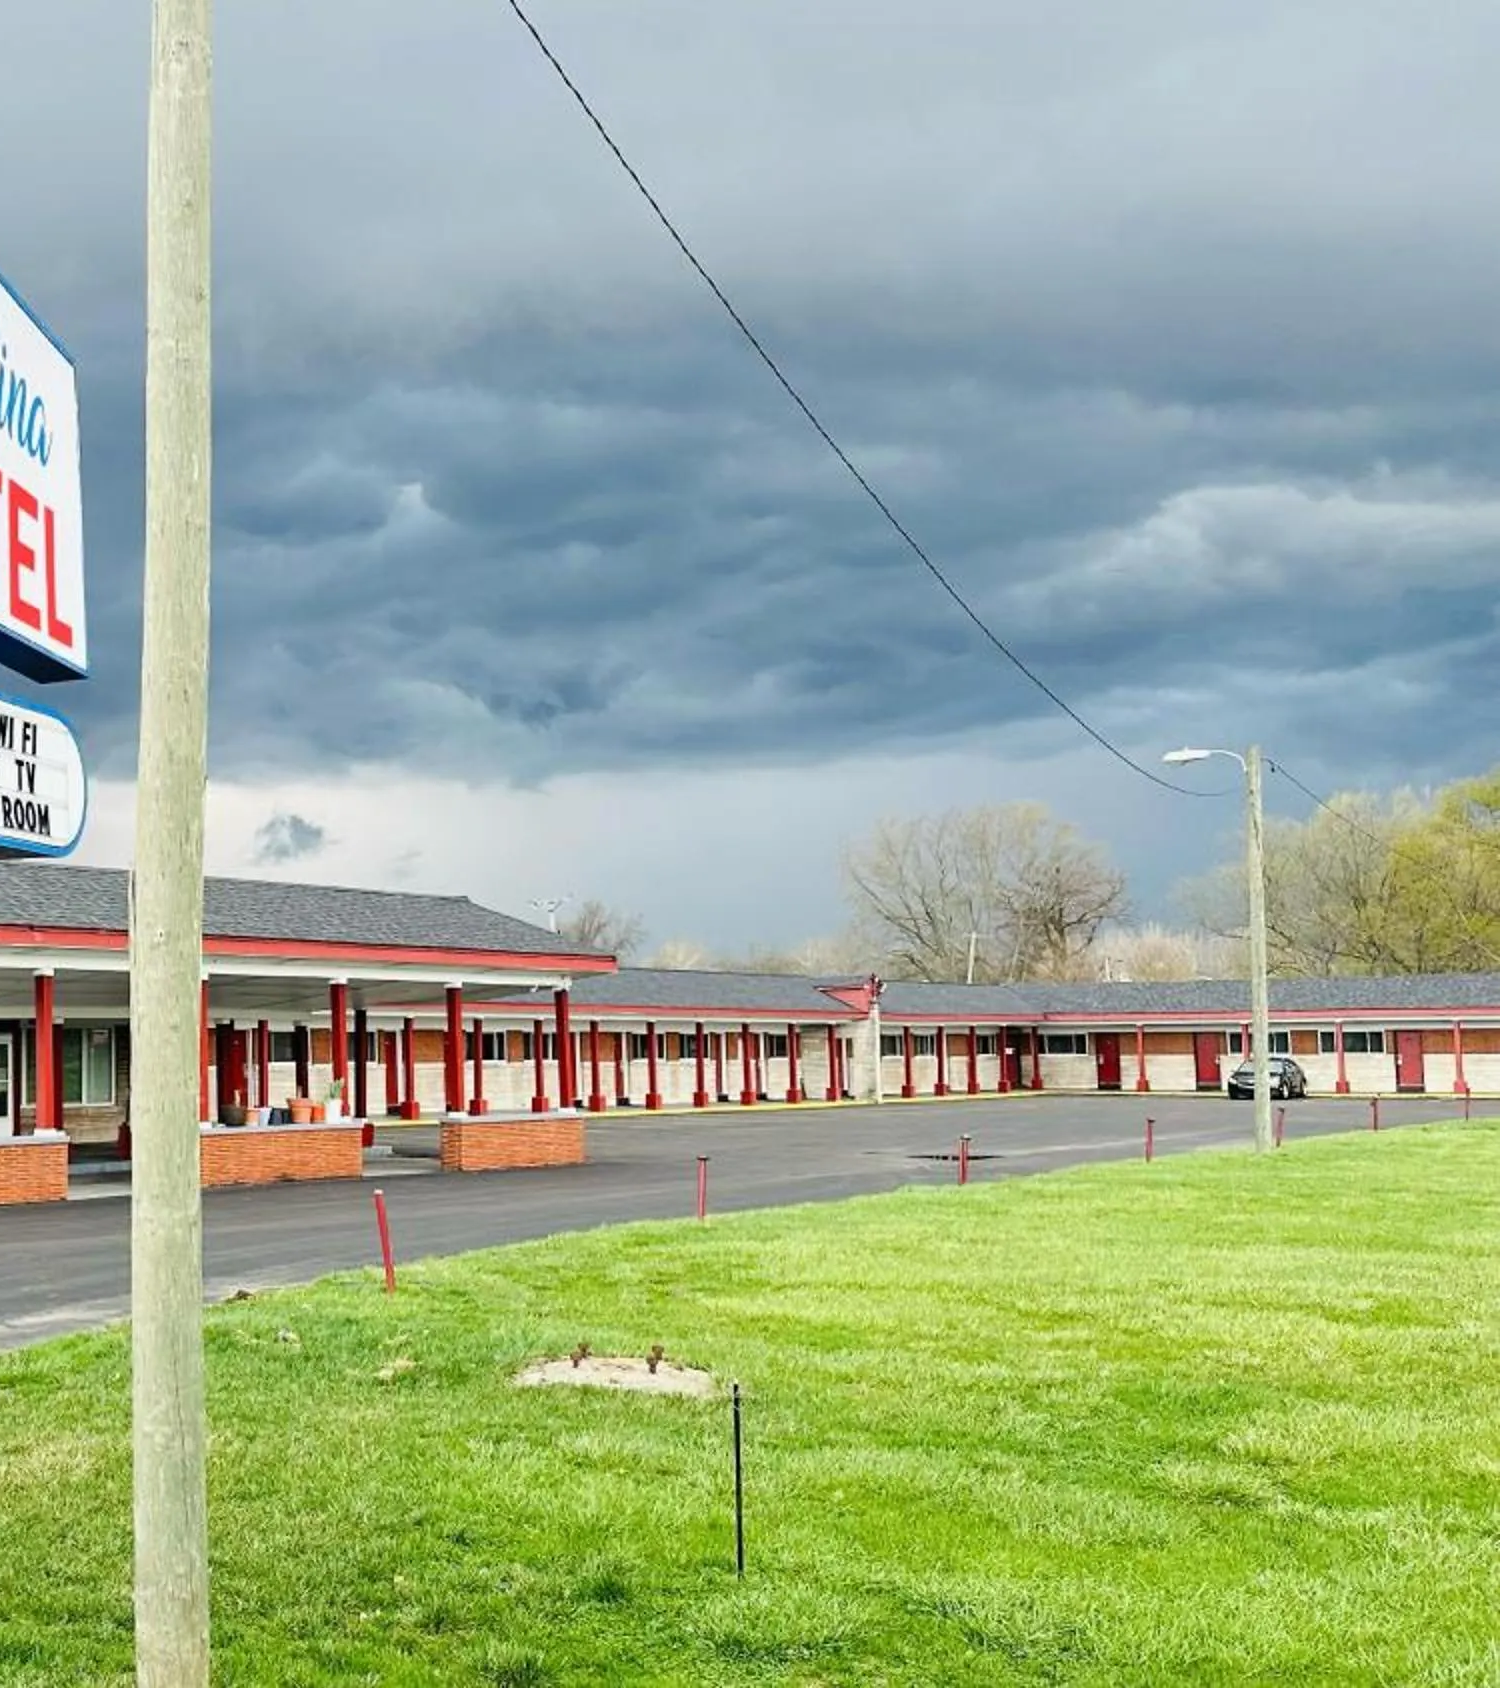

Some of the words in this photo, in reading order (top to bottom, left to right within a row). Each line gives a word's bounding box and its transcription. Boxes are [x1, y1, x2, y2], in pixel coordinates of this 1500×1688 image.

[22, 721, 37, 756] FI
[15, 758, 36, 794] TV
[1, 794, 51, 837] ROOM
